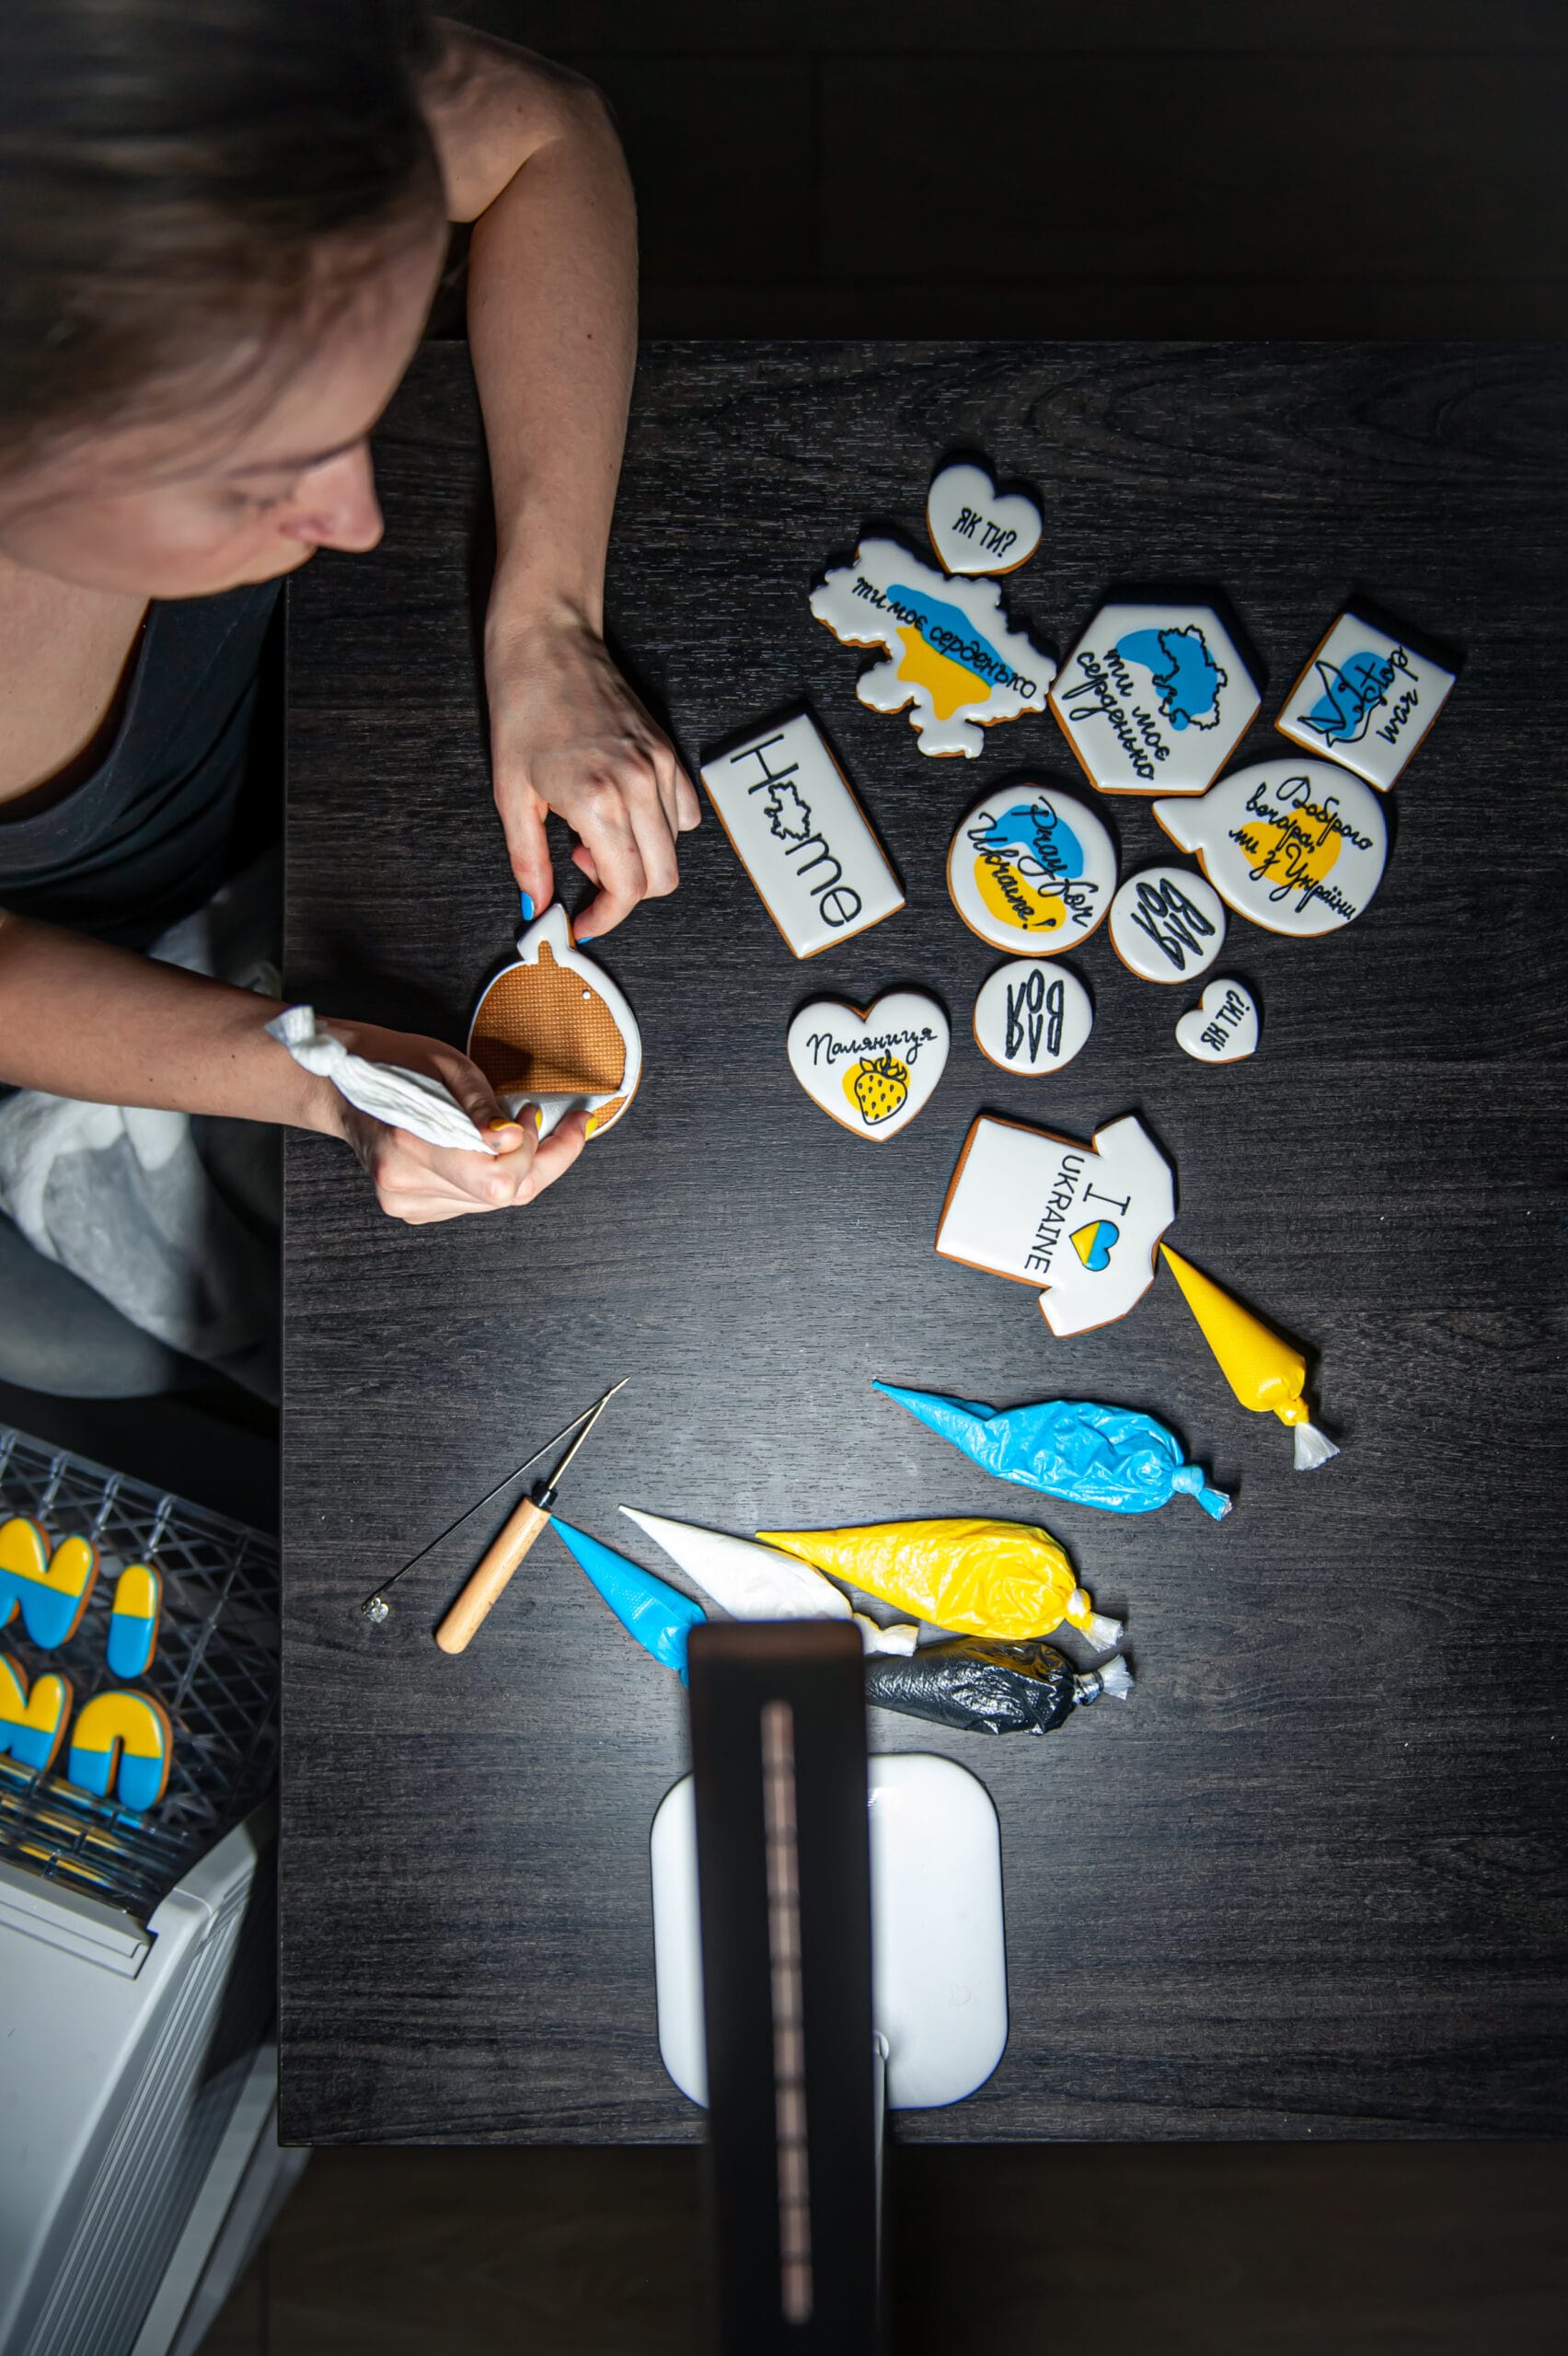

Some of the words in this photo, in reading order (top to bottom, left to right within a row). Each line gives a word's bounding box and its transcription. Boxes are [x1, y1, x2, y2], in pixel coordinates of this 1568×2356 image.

[952, 507, 984, 539] ЯК
[980, 522, 1018, 558] ТИ?
[851, 576, 887, 610] ти
[886, 600, 928, 632] моє
[929, 626, 1037, 699] серденько
[1062, 652, 1155, 780] серденько
[1103, 648, 1134, 698] ти
[1132, 706, 1170, 761] моє
[1376, 688, 1418, 745] war
[1011, 795, 1068, 881] Pray
[1275, 776, 1374, 851] Доброго
[1037, 878, 1100, 929] for
[1269, 842, 1356, 914] України
[806, 1027, 938, 1066] Паляниця
[1200, 1022, 1229, 1052] ЯК
[1216, 989, 1251, 1027] ТИ?
[1024, 1154, 1085, 1274] UKRAINE
[1082, 1183, 1132, 1217] I
